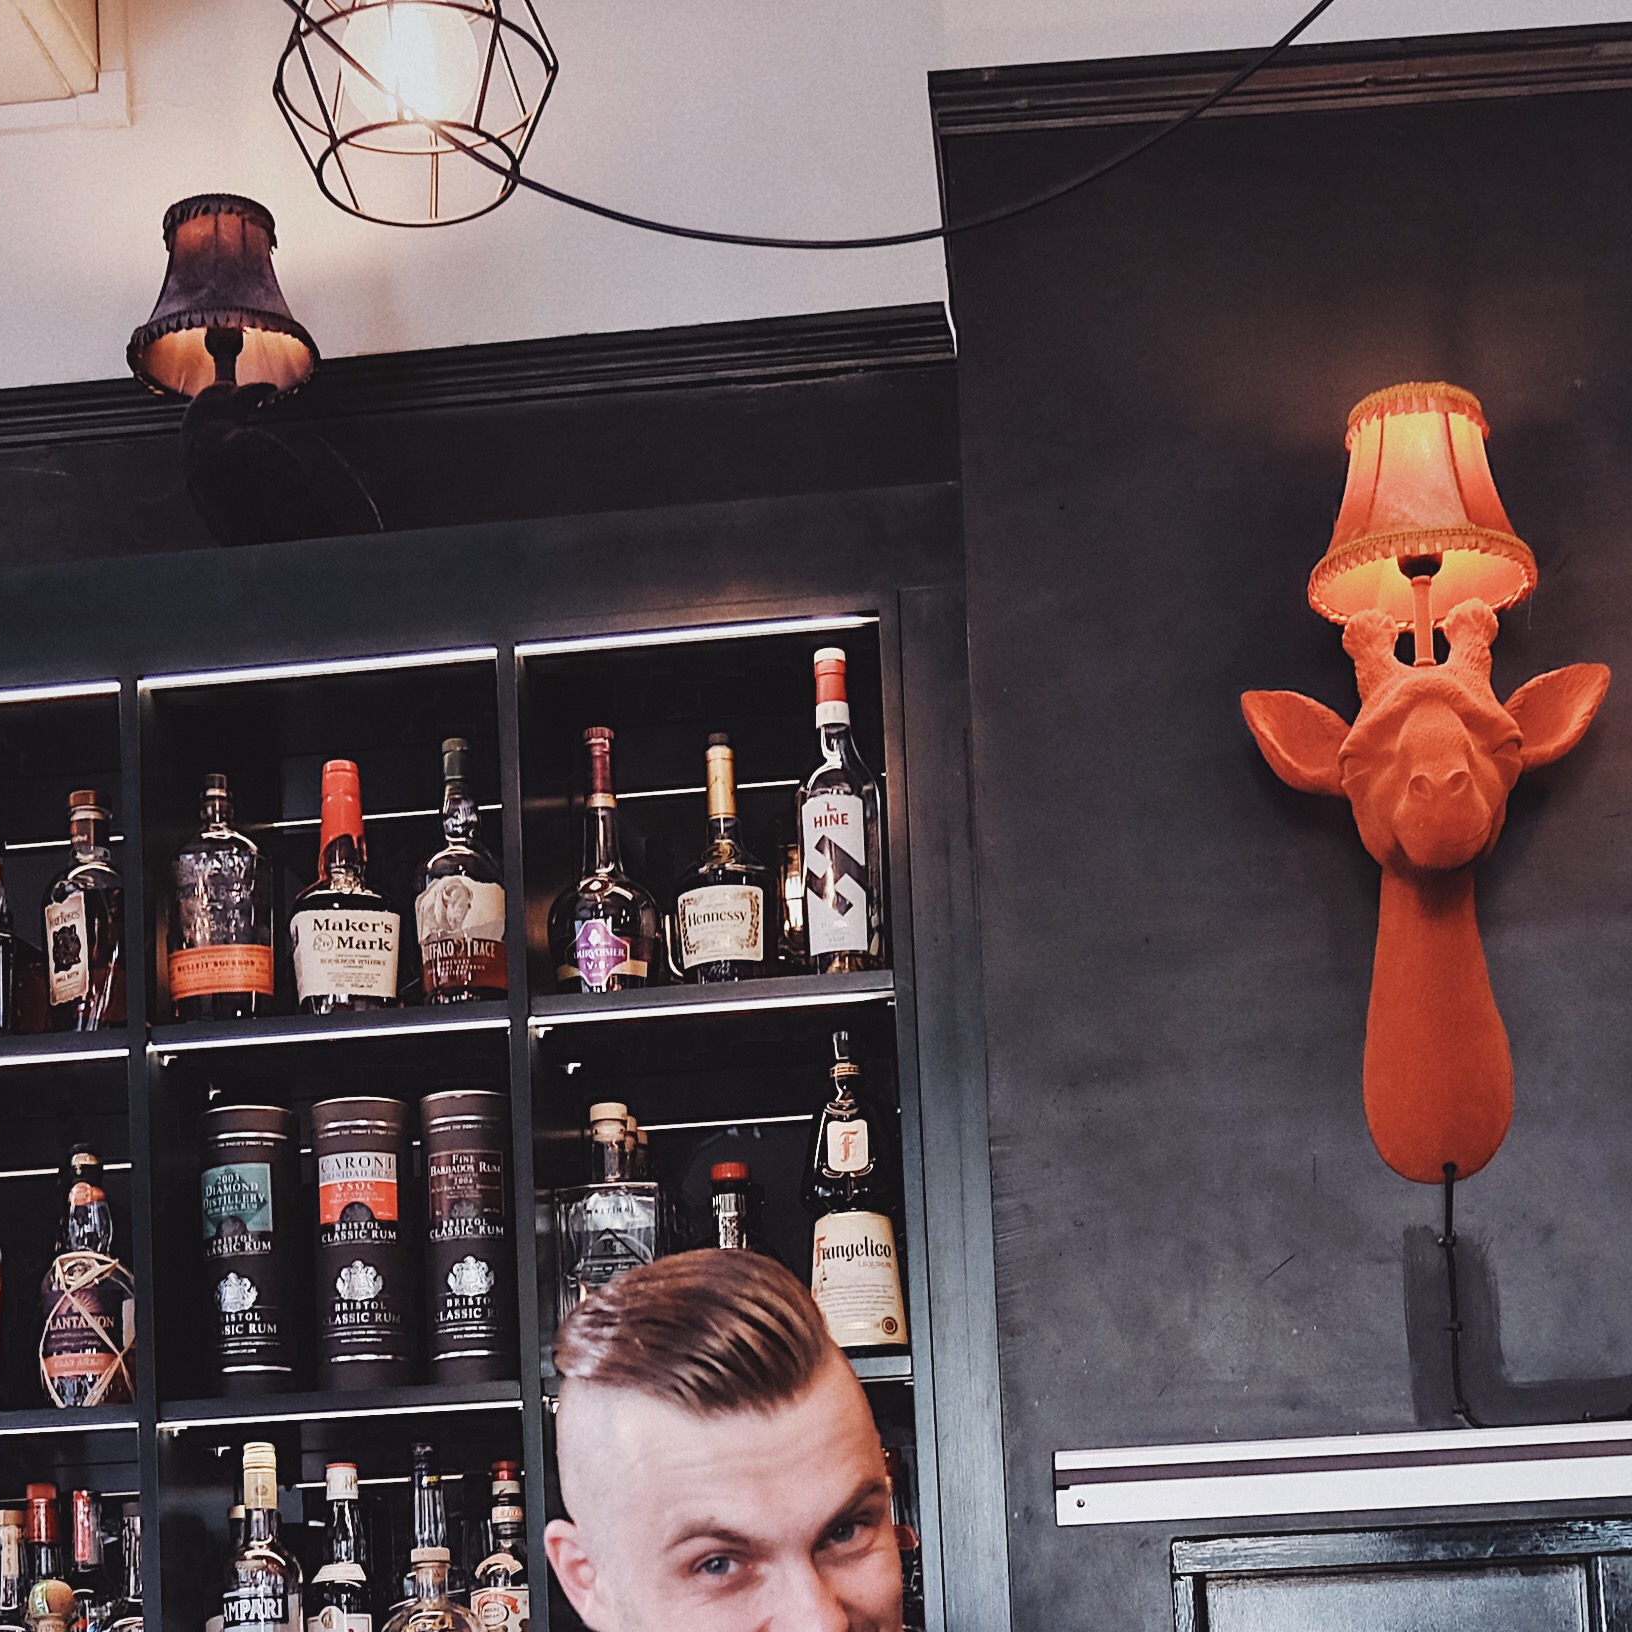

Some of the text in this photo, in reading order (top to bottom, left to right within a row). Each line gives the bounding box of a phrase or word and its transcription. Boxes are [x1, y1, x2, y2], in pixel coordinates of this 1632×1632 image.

[813, 812, 849, 828] HINE
[313, 919, 393, 934] Maker's
[687, 911, 747, 928] Hennessy
[336, 936, 394, 952] Mark
[321, 1156, 396, 1172] CARONI
[478, 1161, 501, 1174] RUM
[204, 1182, 259, 1199] DIAMOND
[203, 1192, 266, 1211] DISTILLERY
[334, 1221, 380, 1231] BRISTOL
[441, 1217, 488, 1229] BRISTOL
[321, 1228, 396, 1243] CLASSIC RUM
[429, 1224, 504, 1240] CLASSIC RUM
[244, 1239, 272, 1253] RUM
[814, 1234, 893, 1268] Frangelico
[334, 1300, 386, 1312] BRISTOL
[446, 1296, 491, 1307] BRISTO
[248, 1323, 278, 1335] RUM
[223, 1597, 284, 1623] AMPARI
